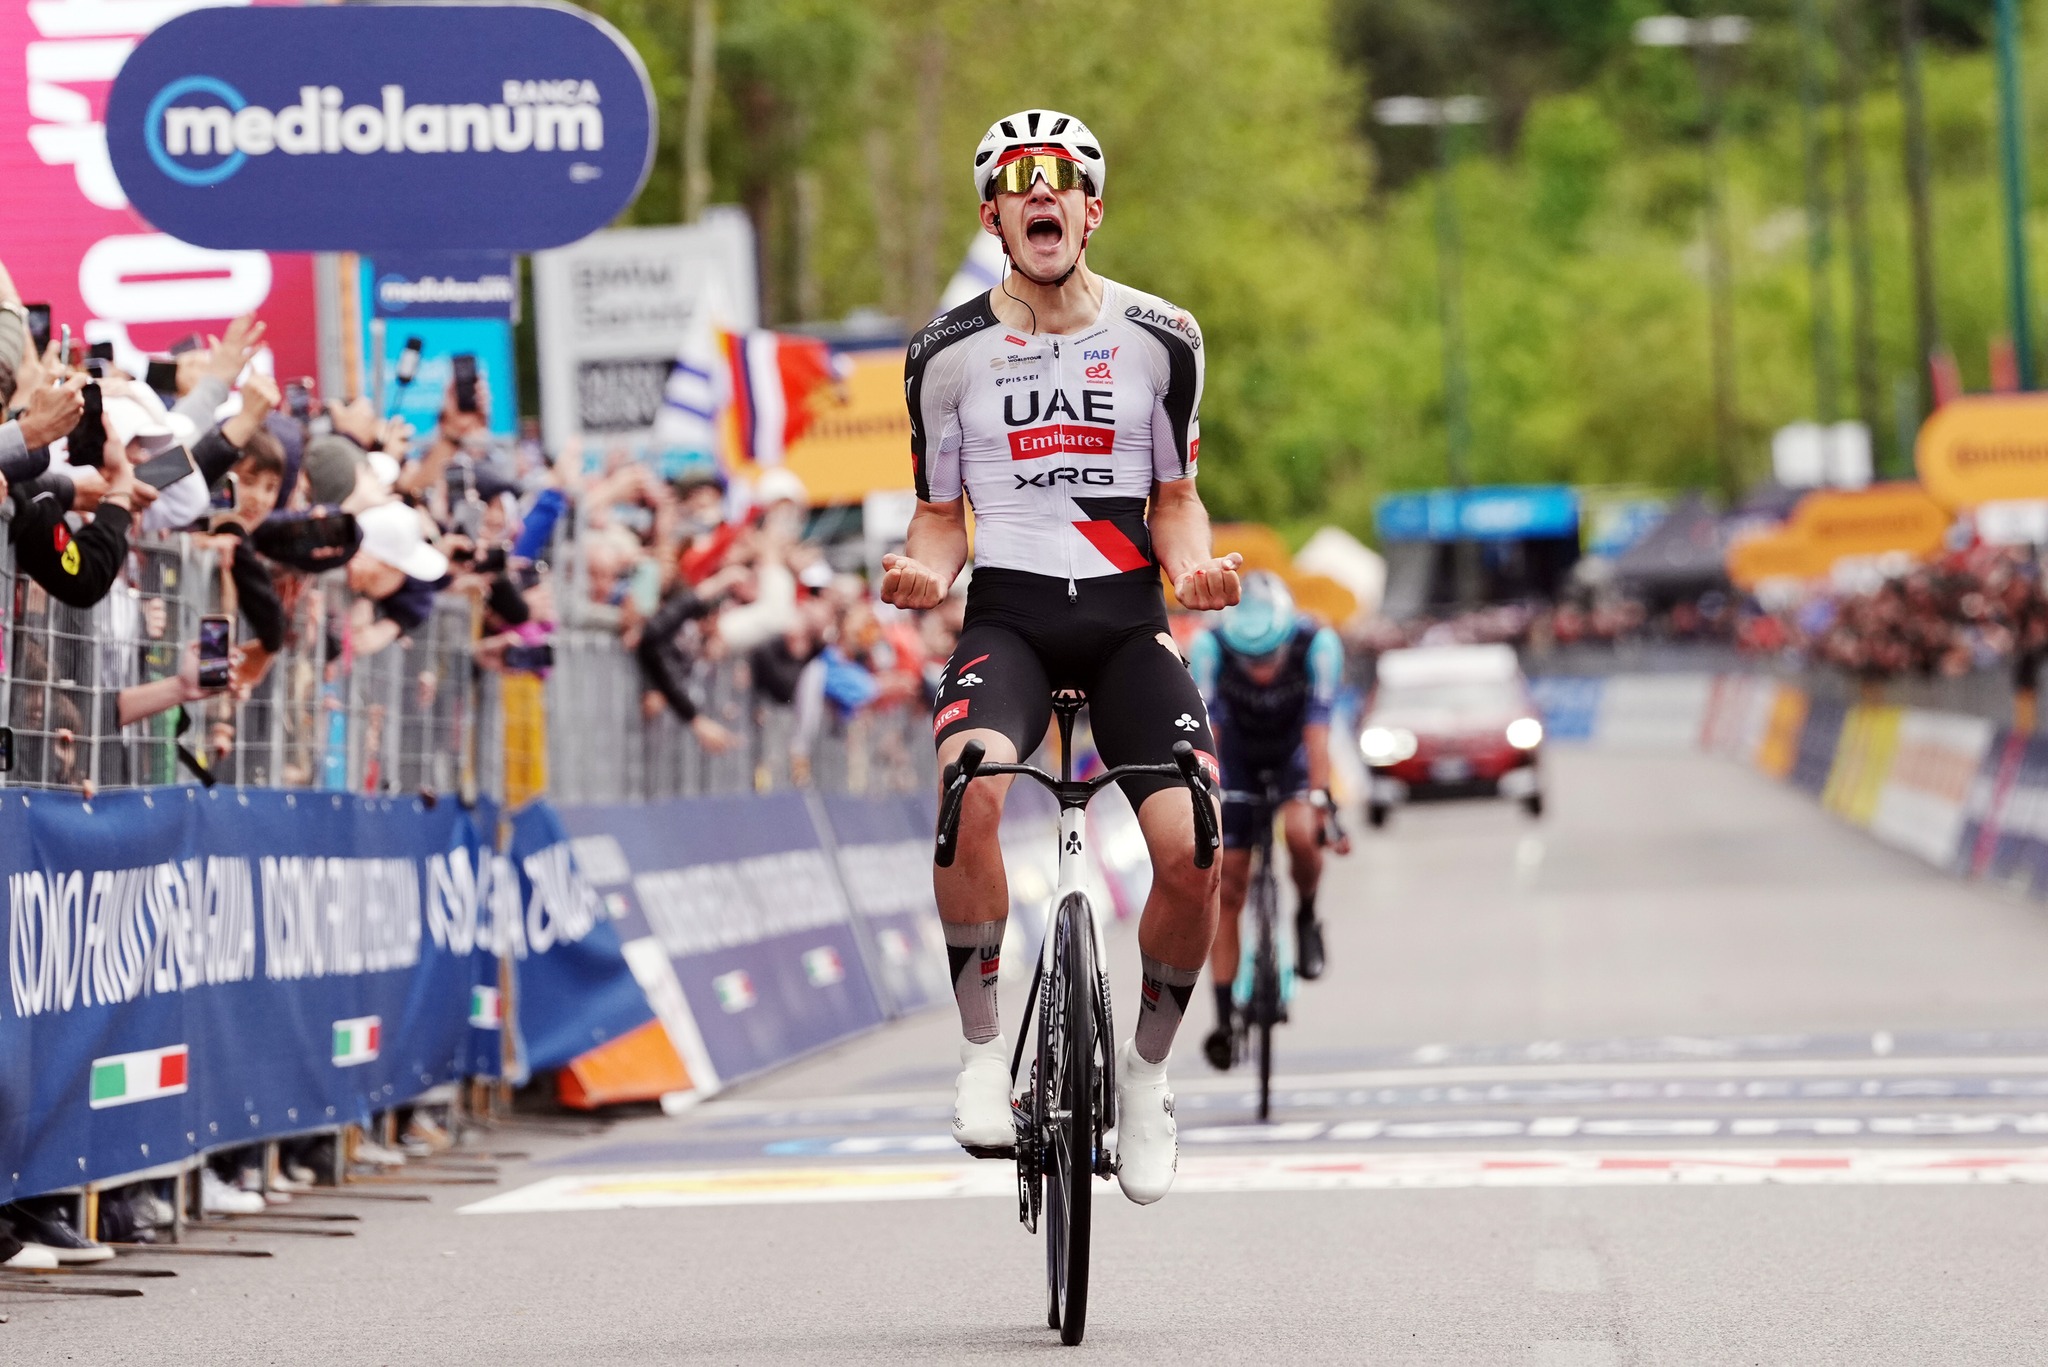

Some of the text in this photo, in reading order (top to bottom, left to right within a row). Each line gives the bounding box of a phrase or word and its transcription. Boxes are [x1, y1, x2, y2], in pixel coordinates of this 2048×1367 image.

[503, 79, 602, 106] BANCA
[165, 84, 604, 156] mediolanum
[923, 316, 985, 347] Analog
[1141, 309, 1201, 350] Analog
[1083, 349, 1110, 361] FAB
[1005, 374, 1039, 384] PISSEI
[1003, 388, 1116, 427] UAE
[1018, 430, 1104, 452] Emirates
[1013, 467, 1114, 490] XRG
[981, 944, 1000, 961] UA
[982, 975, 999, 988] XR
